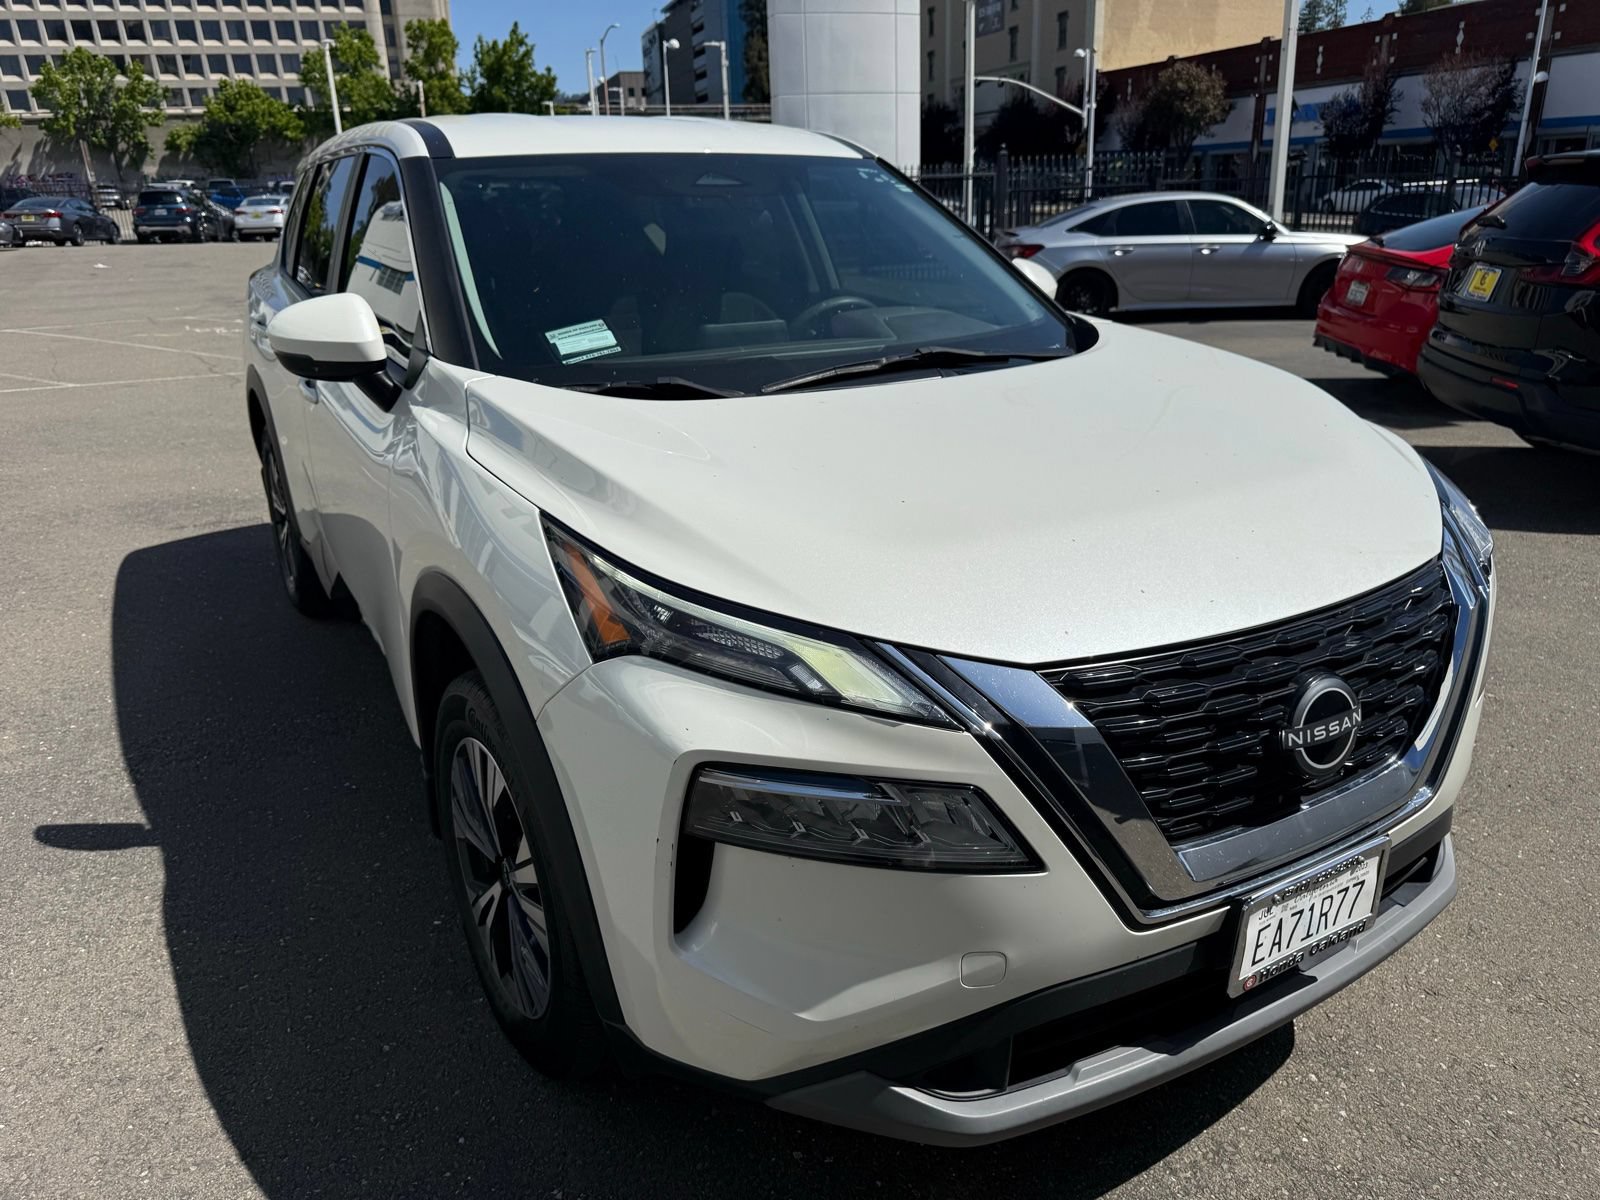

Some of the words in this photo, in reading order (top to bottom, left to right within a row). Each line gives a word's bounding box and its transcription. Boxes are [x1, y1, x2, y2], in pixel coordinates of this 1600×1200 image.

[1287, 708, 1361, 747] NISSAN
[1251, 880, 1366, 967] EA71R77
[1259, 951, 1304, 983] Honda
[1309, 919, 1367, 957] Oakland
